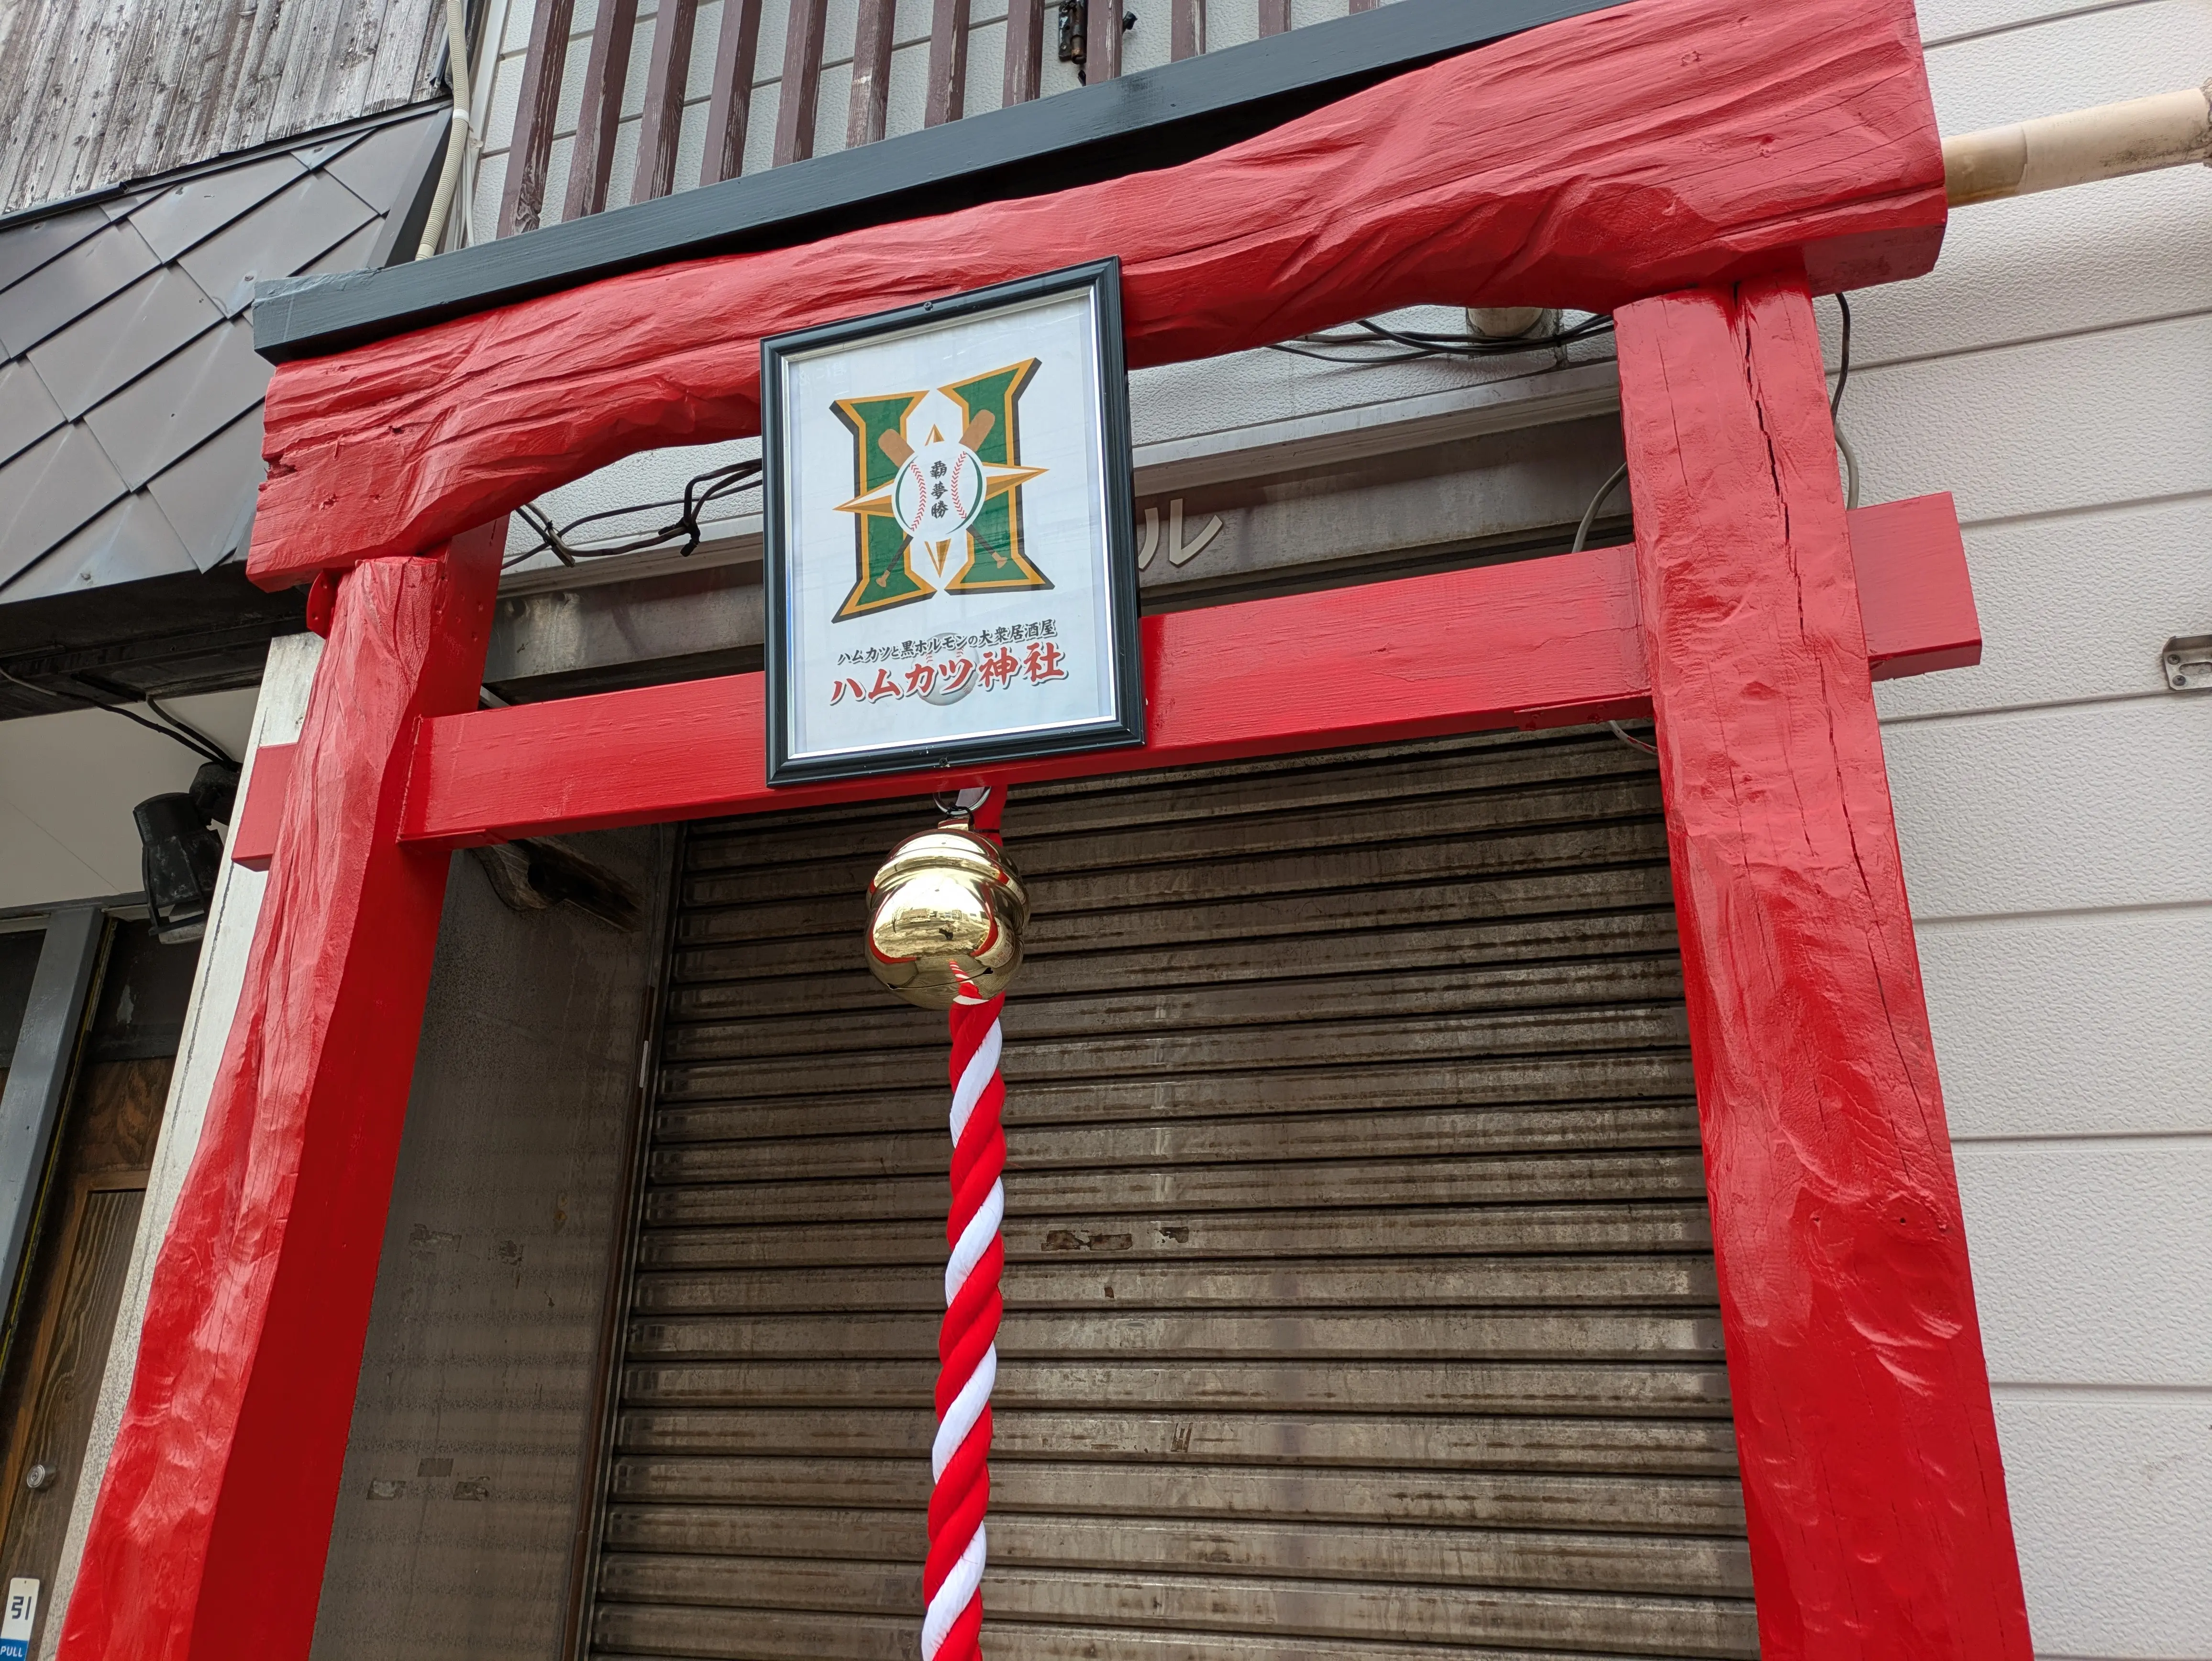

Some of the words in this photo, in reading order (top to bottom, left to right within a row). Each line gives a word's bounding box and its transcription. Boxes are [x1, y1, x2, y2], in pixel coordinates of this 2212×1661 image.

[837, 619, 1057, 665] ハムカツと黒ホルモンの大衆居酒屋
[830, 642, 1069, 706] ハムカツ神社
[11, 1596, 32, 1621] 引
[0, 1645, 23, 1657] PULL
